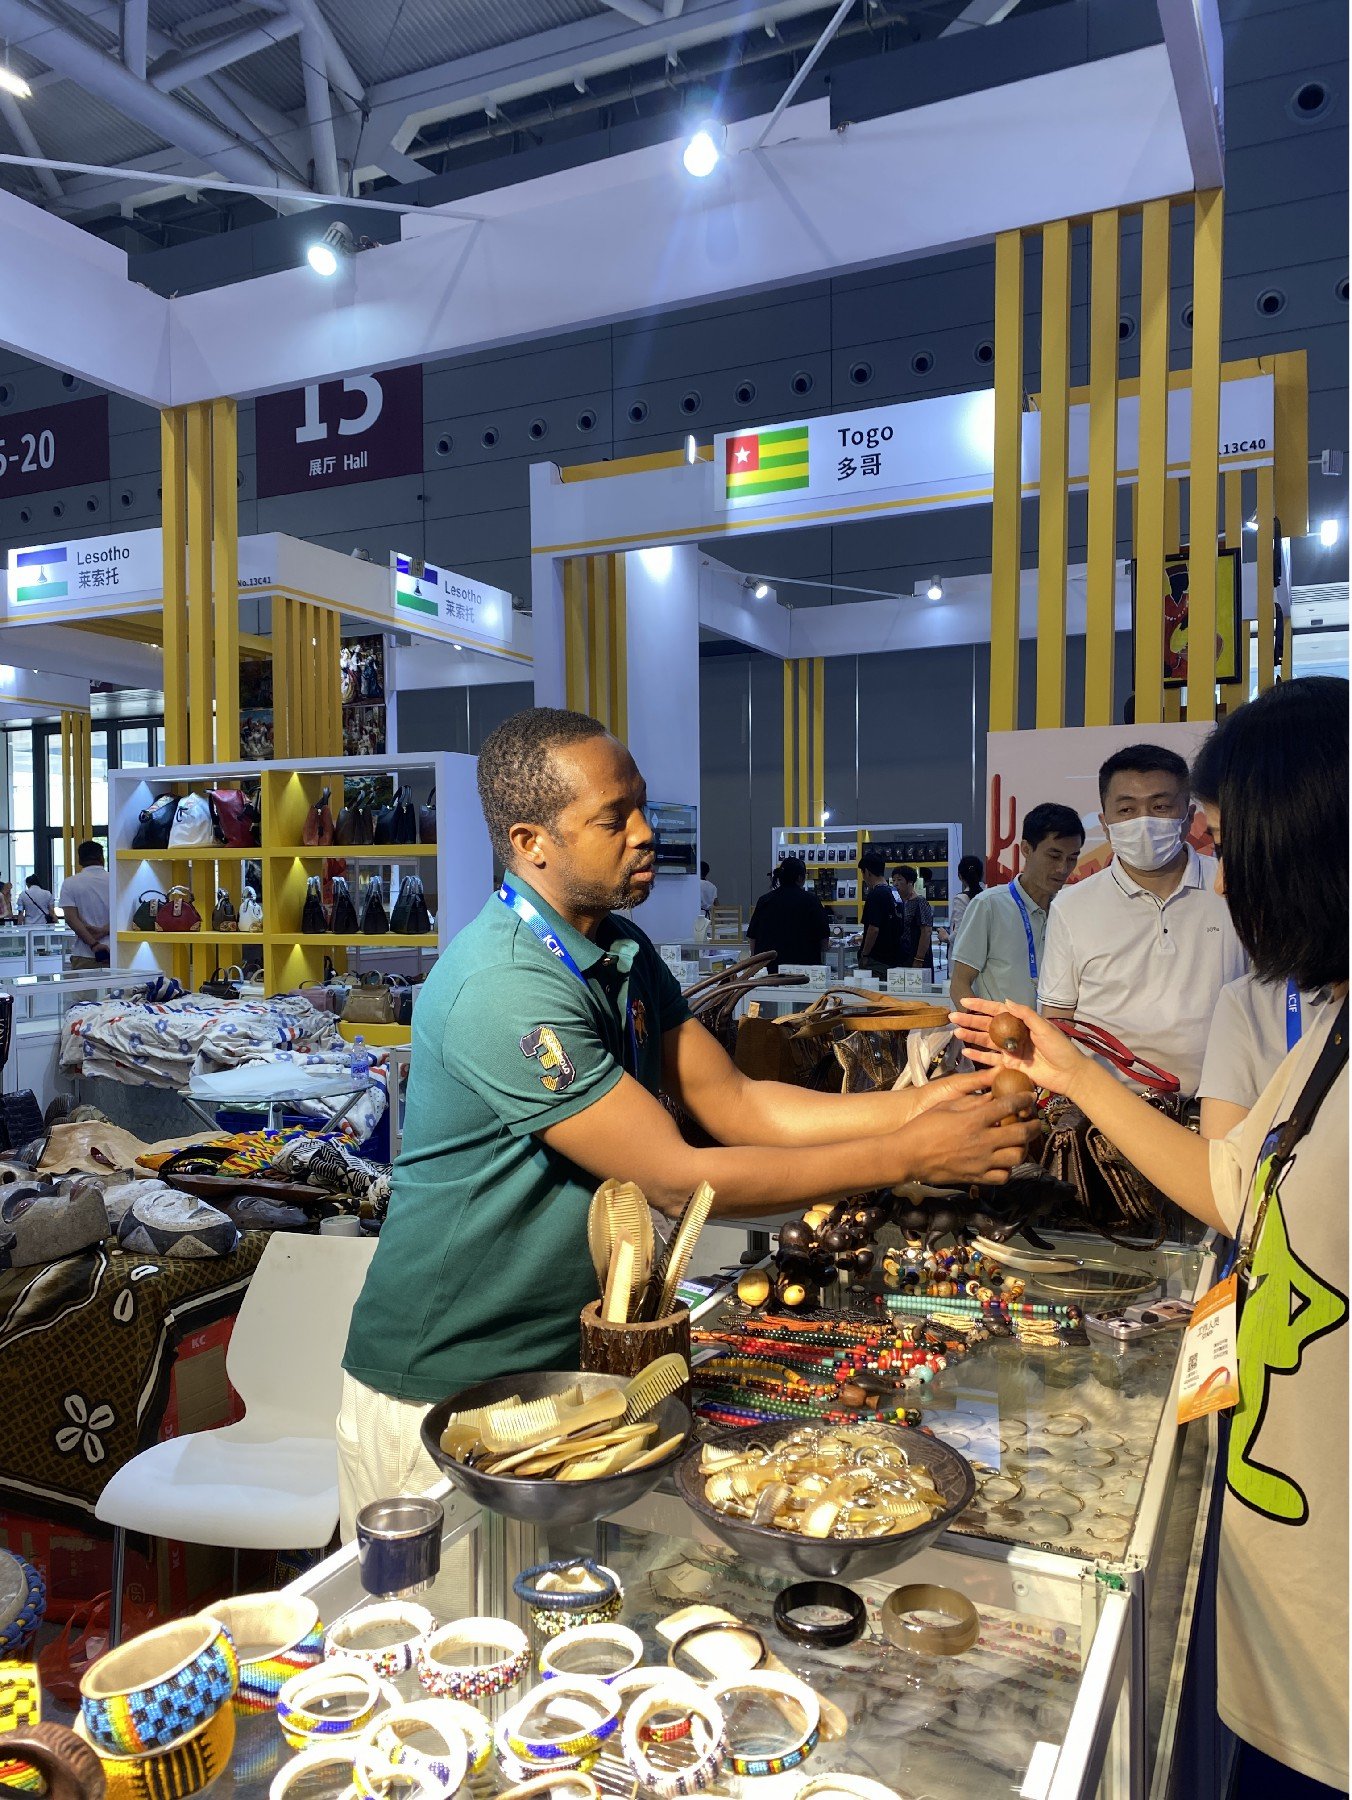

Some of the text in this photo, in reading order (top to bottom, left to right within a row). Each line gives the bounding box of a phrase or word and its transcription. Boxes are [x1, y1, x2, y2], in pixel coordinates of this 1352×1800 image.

[837, 426, 894, 449] Togo
[309, 451, 368, 477] 展厅 Hall
[837, 453, 882, 481] 多哥
[77, 545, 130, 566] Lesotho
[78, 566, 120, 589] 莱索托
[444, 580, 482, 605] Lesotho
[445, 599, 475, 624] 莱索托
[543, 934, 565, 958] ICIF
[1288, 993, 1298, 1013] ICIF
[191, 1335, 206, 1349] KC
